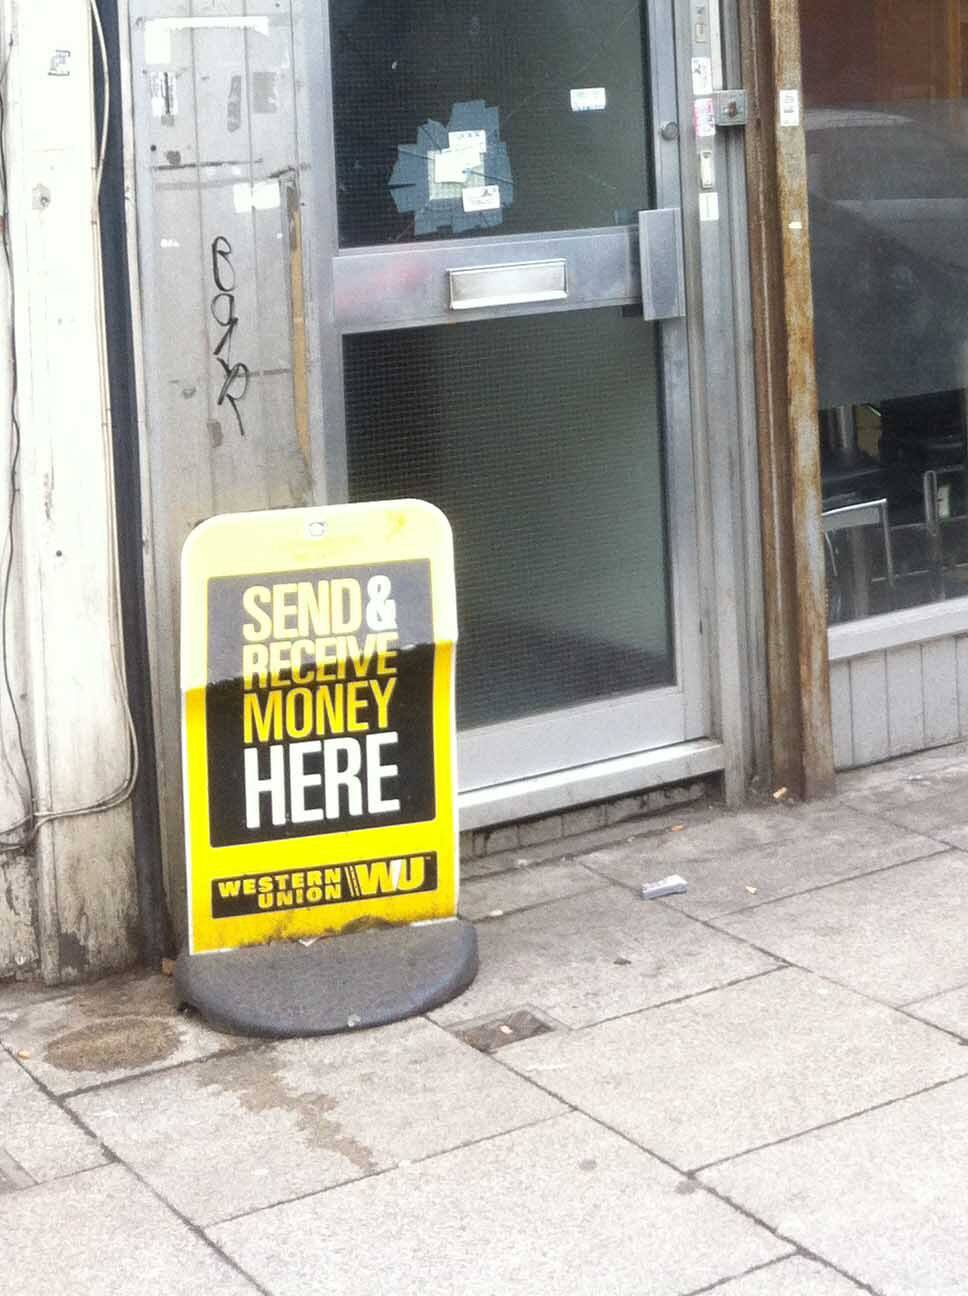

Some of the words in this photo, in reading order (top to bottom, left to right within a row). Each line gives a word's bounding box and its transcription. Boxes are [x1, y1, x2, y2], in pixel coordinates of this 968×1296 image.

[242, 578, 363, 641] SEND
[366, 575, 397, 630] &
[242, 632, 398, 690] RECEIVE
[243, 677, 397, 744] MONEY
[244, 731, 400, 829] HERE
[217, 867, 342, 897] WESTERN
[258, 886, 342, 909] UNION
